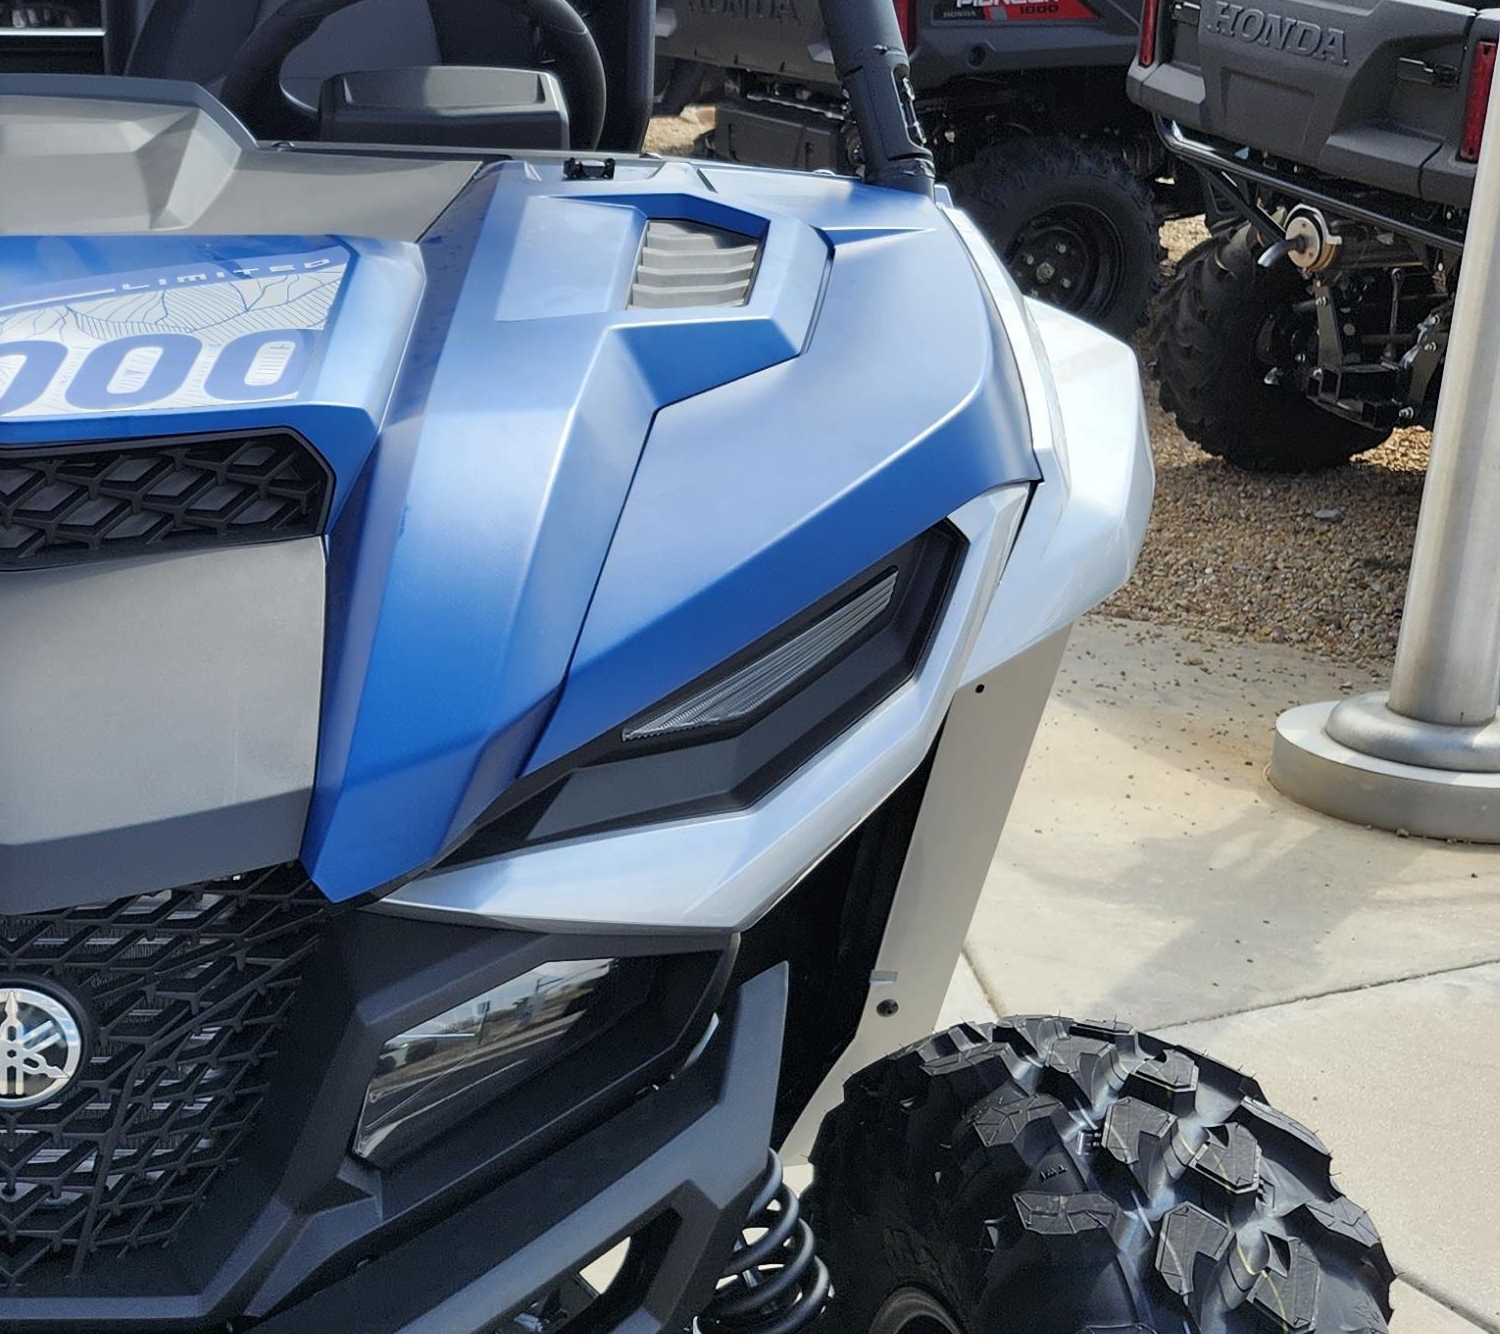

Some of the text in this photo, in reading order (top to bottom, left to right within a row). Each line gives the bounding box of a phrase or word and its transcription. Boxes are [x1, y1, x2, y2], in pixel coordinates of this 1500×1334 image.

[1020, 4, 1060, 15] 1000
[1206, 1, 1350, 67] HONDA
[122, 258, 331, 291] LIMITED
